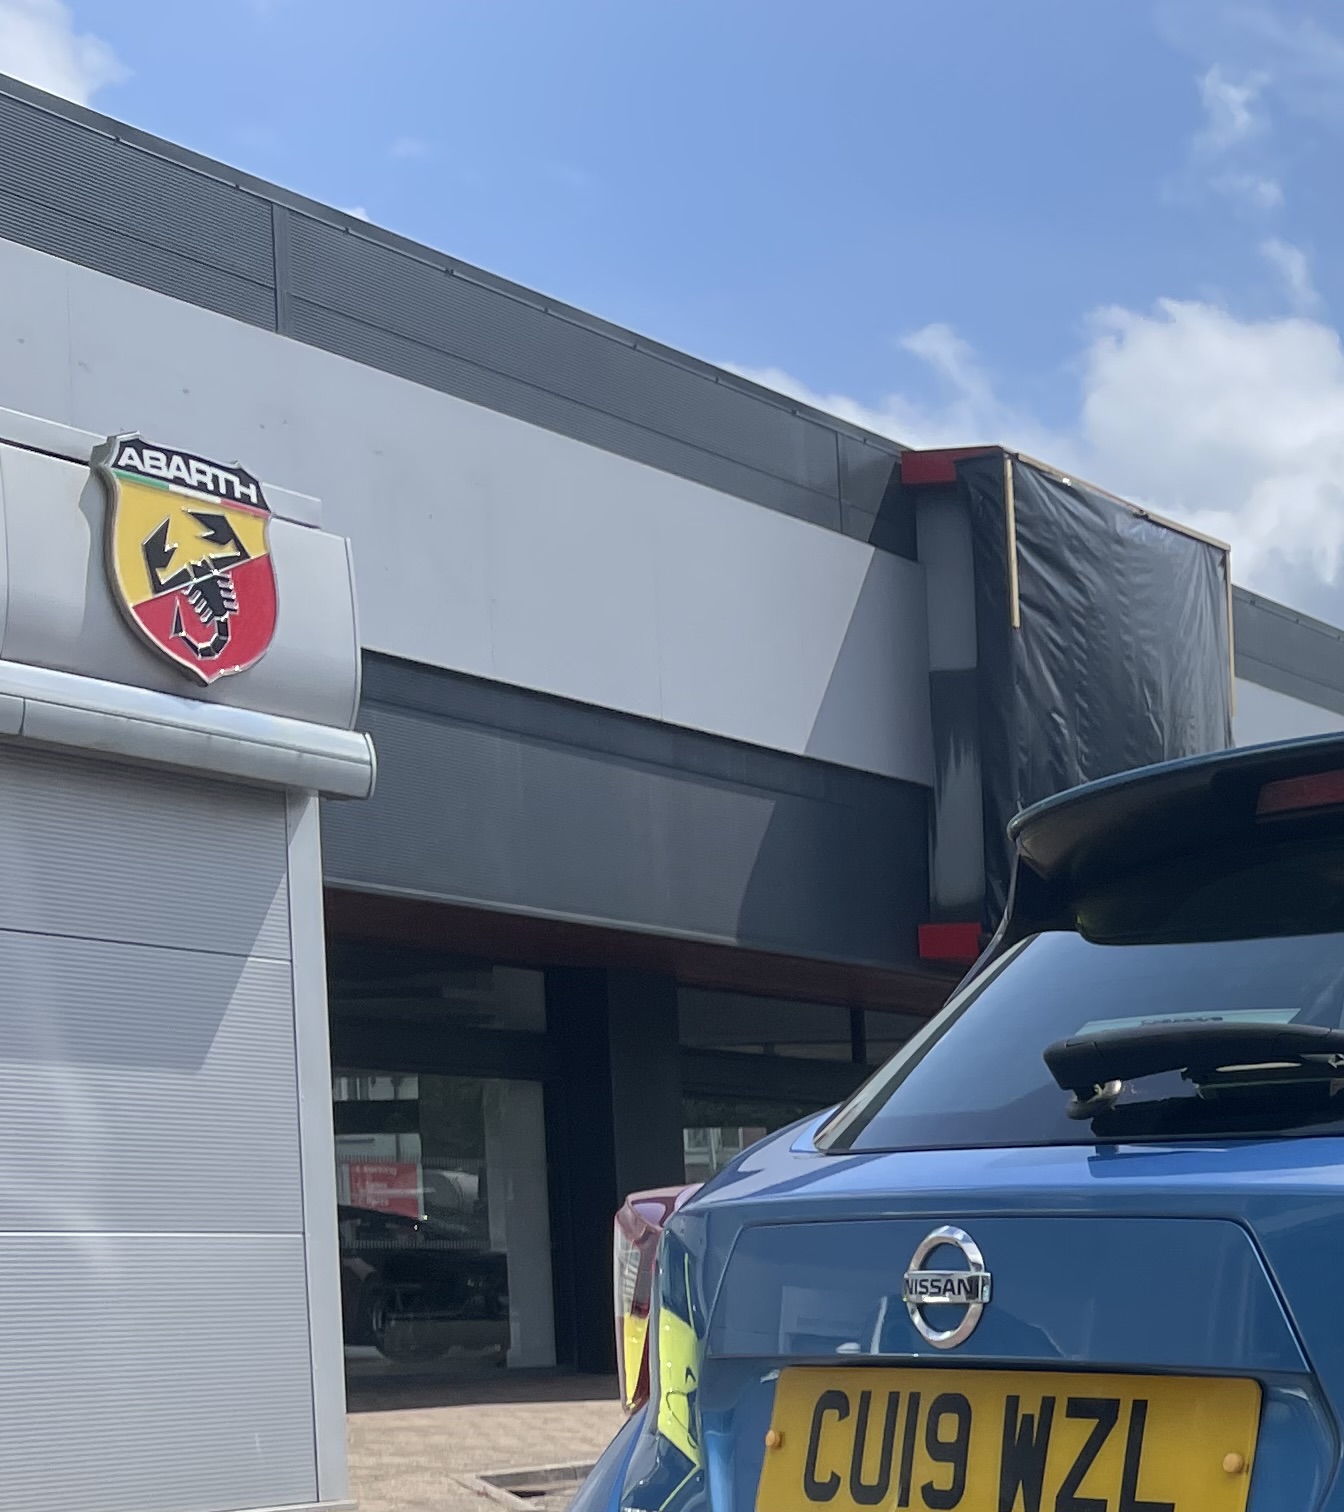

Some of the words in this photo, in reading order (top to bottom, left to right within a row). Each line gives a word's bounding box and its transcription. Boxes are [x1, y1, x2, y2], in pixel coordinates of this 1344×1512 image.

[118, 447, 257, 503] ABARTH
[905, 1277, 974, 1296] NISSAN
[803, 1389, 972, 1511] CU19
